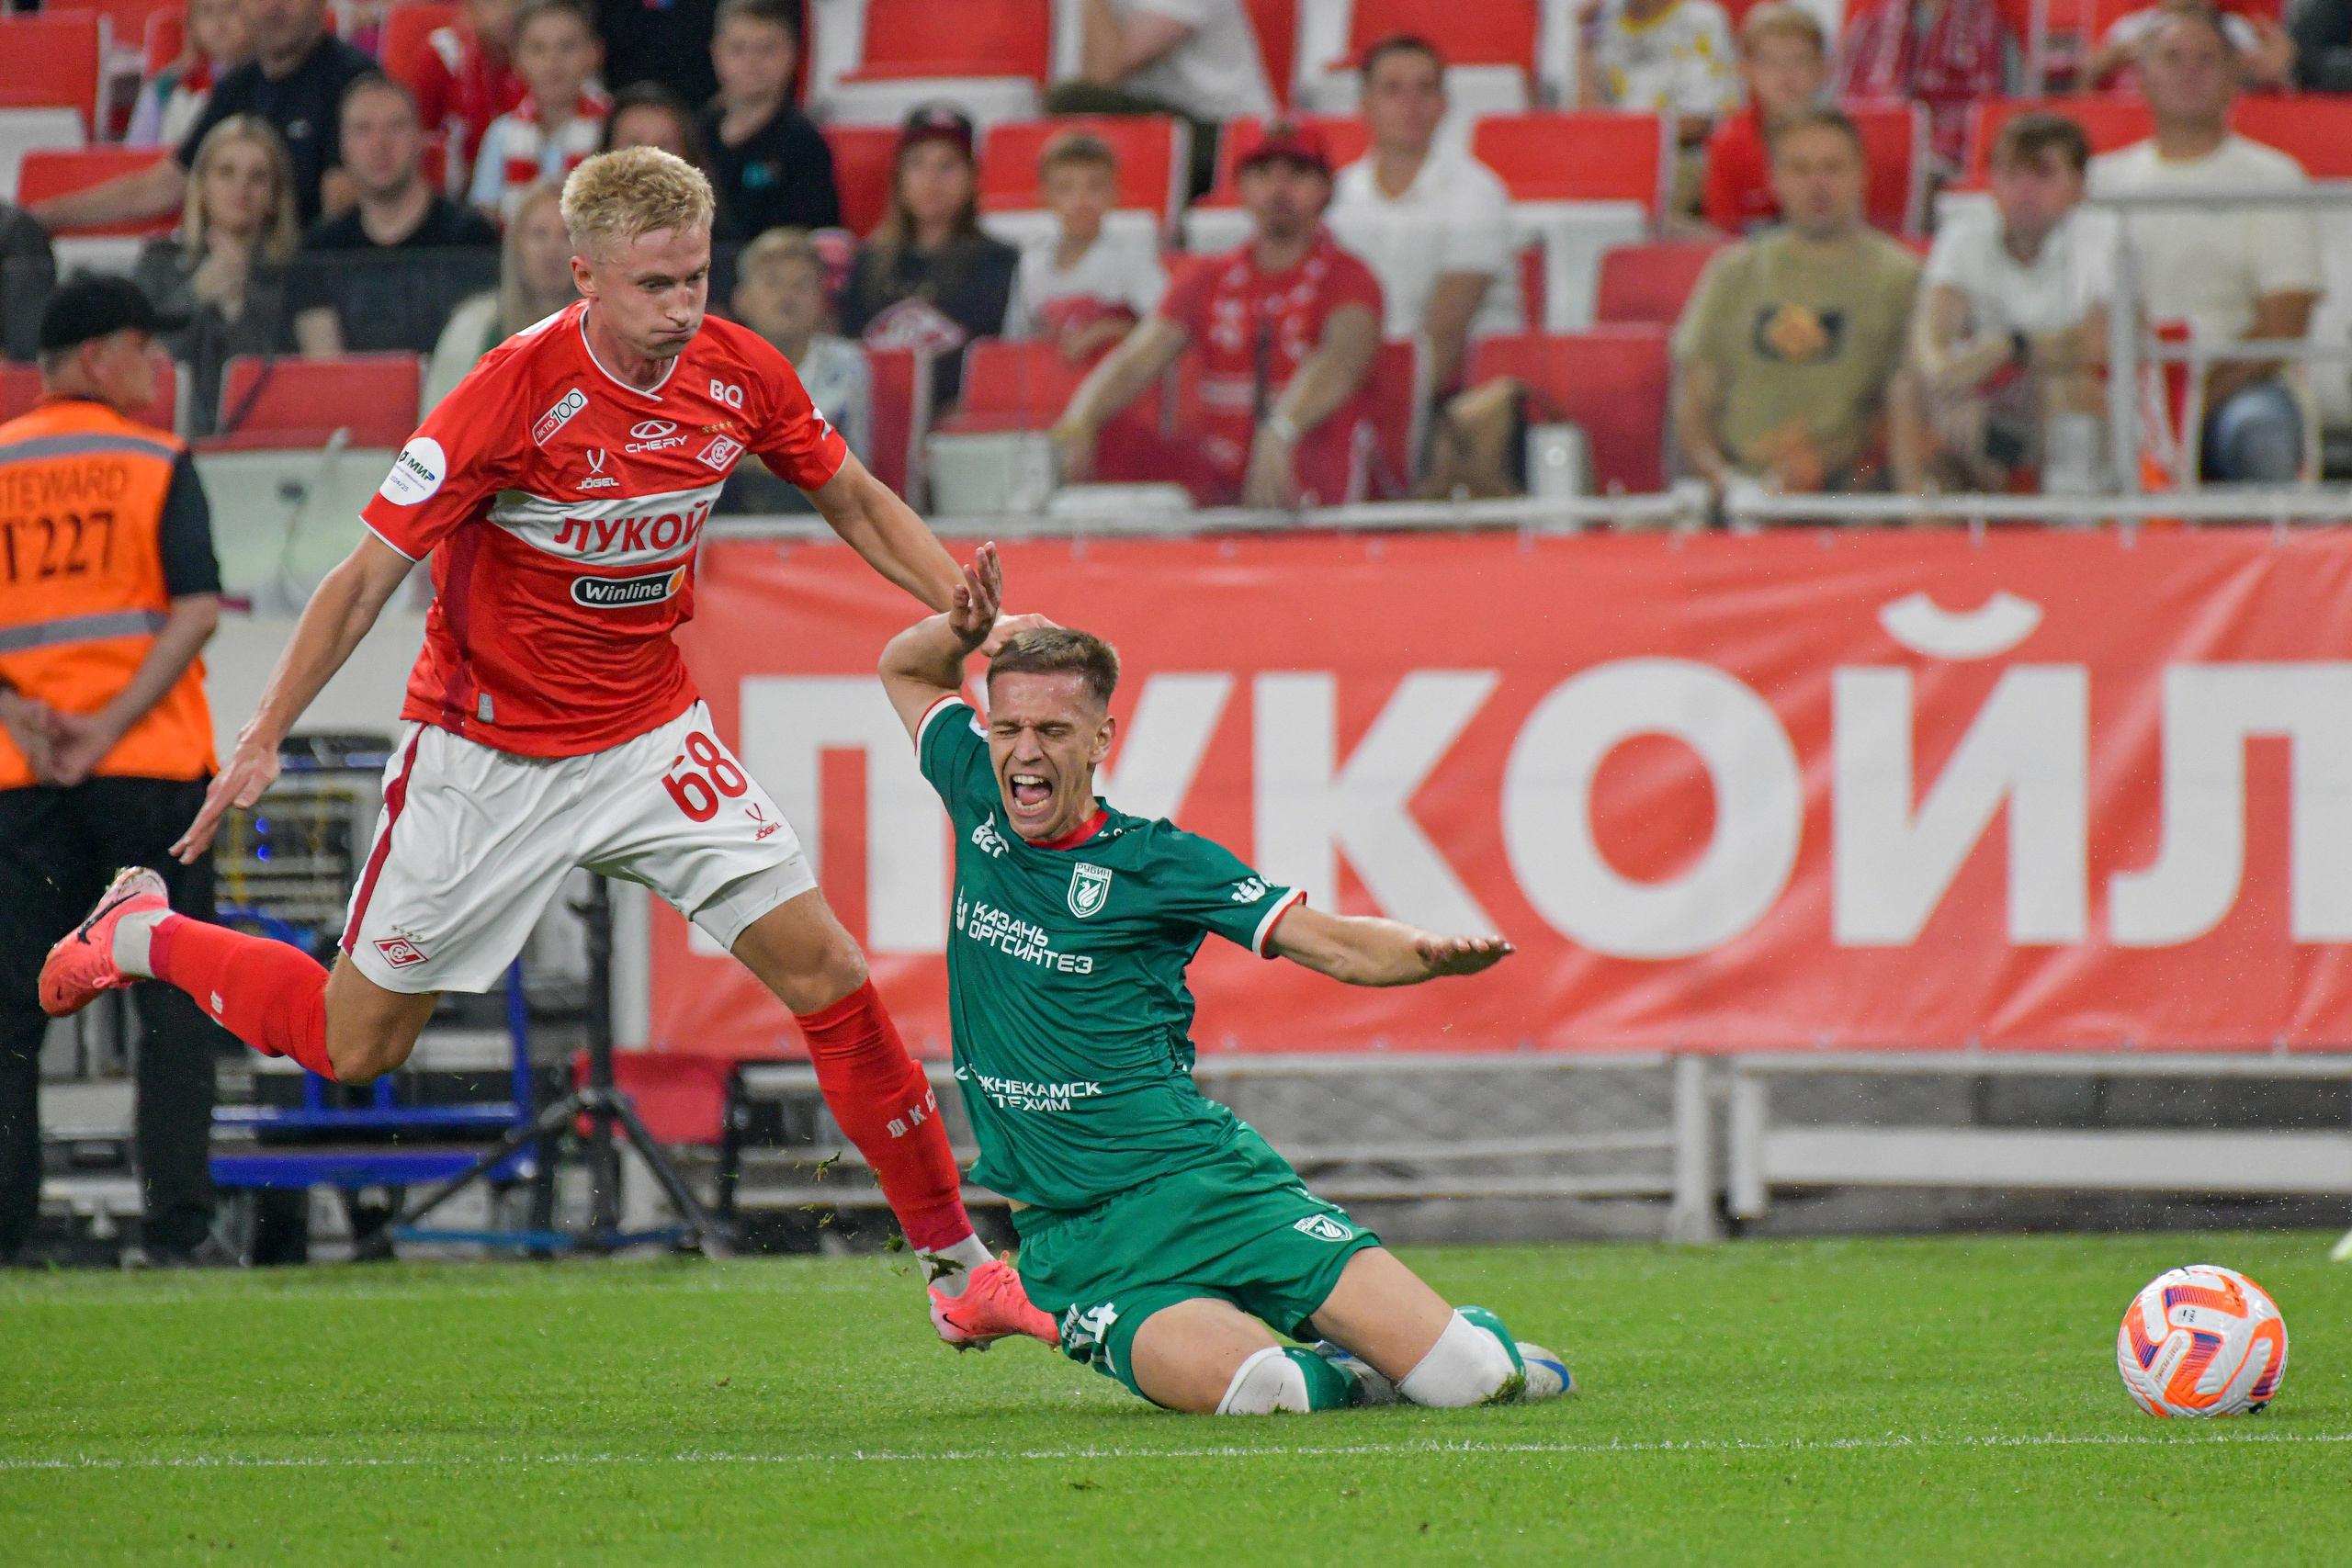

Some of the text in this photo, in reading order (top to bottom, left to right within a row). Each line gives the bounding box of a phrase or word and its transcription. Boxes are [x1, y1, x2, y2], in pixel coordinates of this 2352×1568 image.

[551, 392, 583, 424] 100
[709, 378, 743, 410] BQ
[625, 434, 688, 454] CHERY
[406, 457, 435, 482] МИР
[576, 477, 620, 491] JÖGEL
[553, 500, 709, 553] ЛУКОЙ
[585, 581, 663, 602] Winline
[661, 730, 748, 823] 68
[972, 900, 1049, 948] КАЗАНЬ
[968, 919, 1093, 975] ОРГСИНТЕЗ
[978, 1074, 1102, 1099] ЖНЕКАМСК
